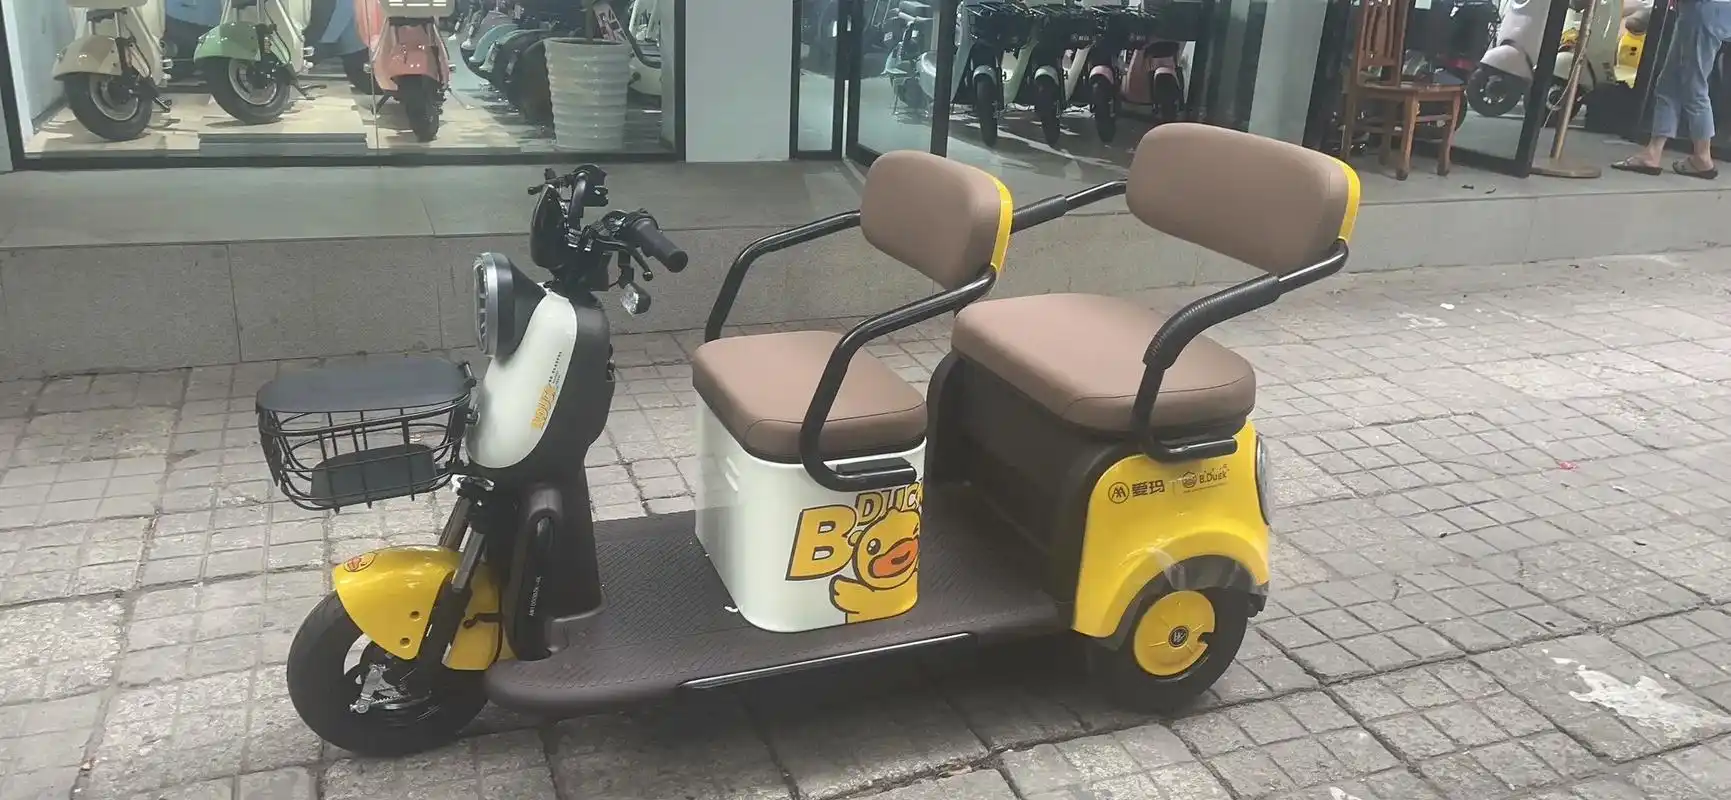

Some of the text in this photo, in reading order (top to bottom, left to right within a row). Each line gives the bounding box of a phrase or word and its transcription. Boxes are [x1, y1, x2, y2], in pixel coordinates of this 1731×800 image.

[1131, 479, 1166, 497] 爱玛
[784, 481, 924, 581] B DUC
